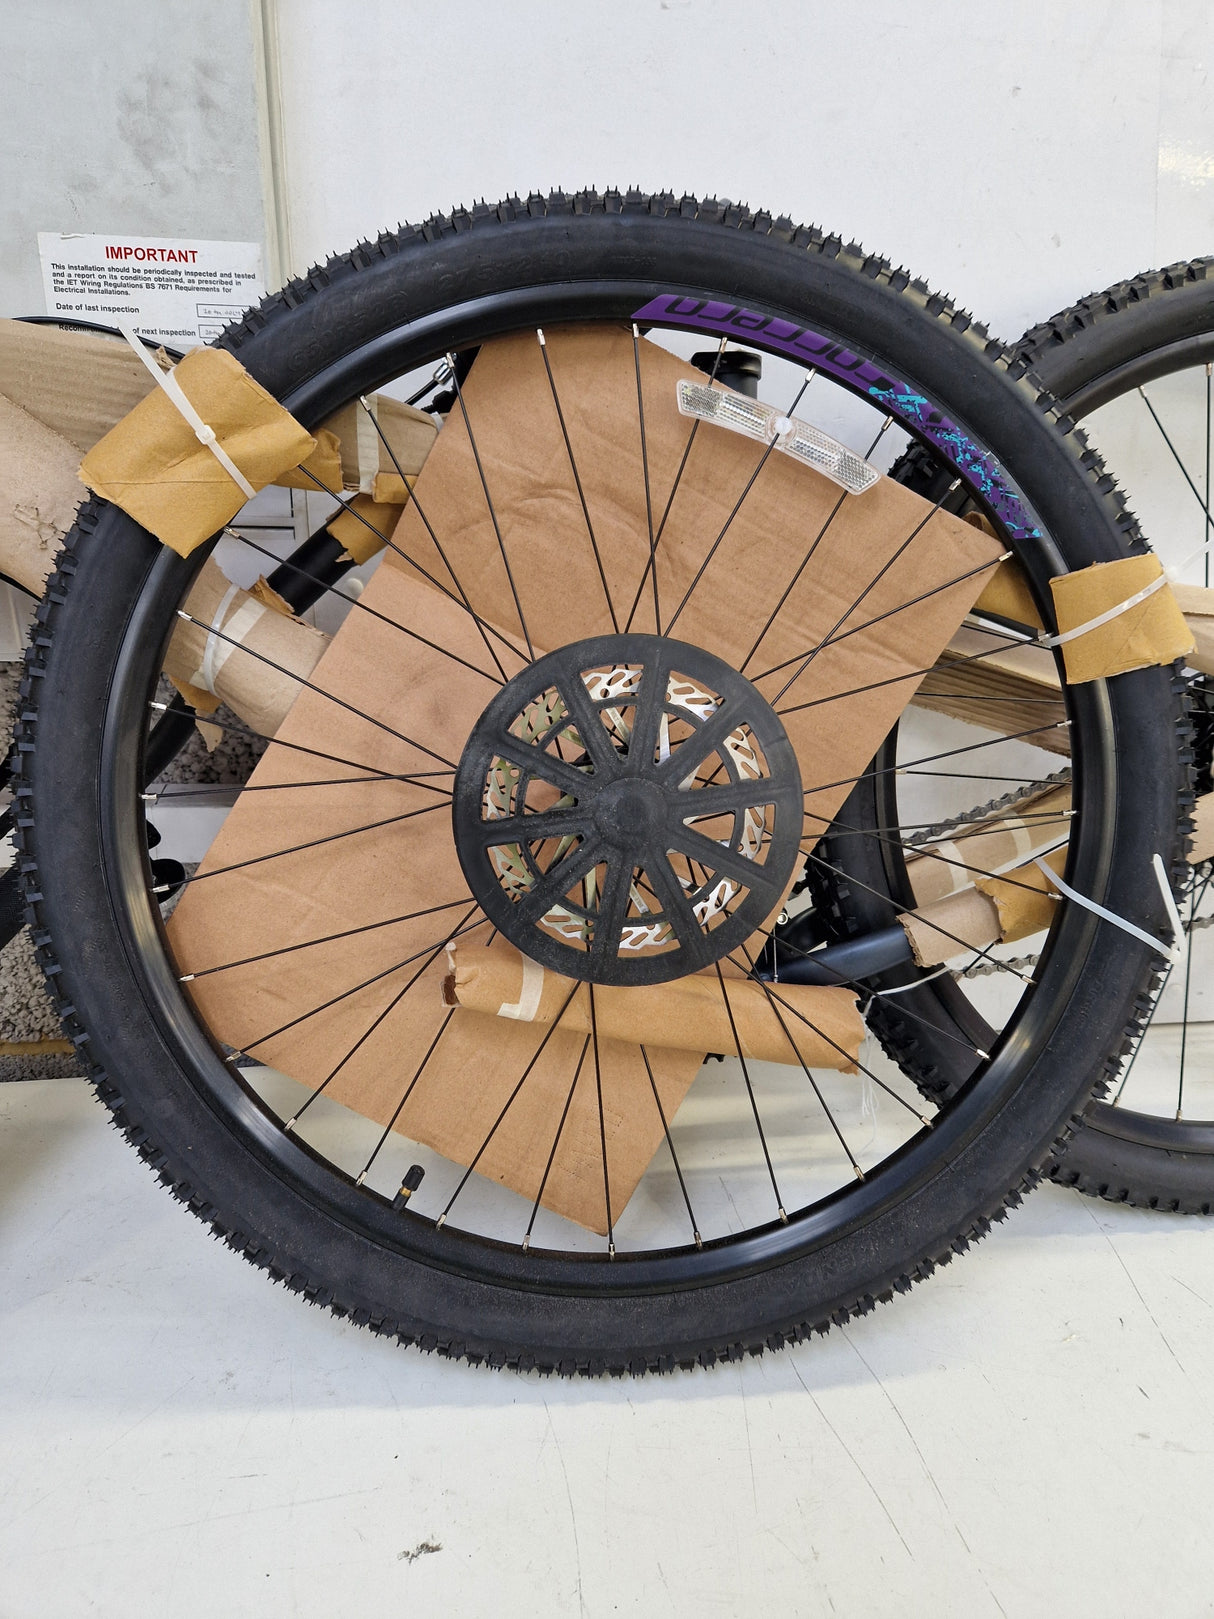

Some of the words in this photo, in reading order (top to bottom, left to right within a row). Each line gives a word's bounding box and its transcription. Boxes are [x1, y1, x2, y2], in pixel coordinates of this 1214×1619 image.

[105, 246, 198, 263] IMPORTANT
[51, 263, 66, 271] This
[67, 264, 105, 272] installation
[107, 266, 130, 274] should
[143, 268, 182, 277] periodically
[184, 270, 218, 278] inspected
[234, 272, 256, 280] tested
[80, 280, 102, 288] Wiring
[103, 281, 144, 289] Regulations
[175, 284, 220, 293] Requirements
[120, 274, 152, 282] condition
[198, 279, 234, 287] prescribed
[53, 285, 86, 294] Electrical
[88, 287, 131, 296] Installations.
[56, 302, 74, 311] Date
[85, 304, 99, 312] last
[100, 305, 140, 314] inspection
[132, 327, 140, 335] of
[159, 328, 196, 337] inspection
